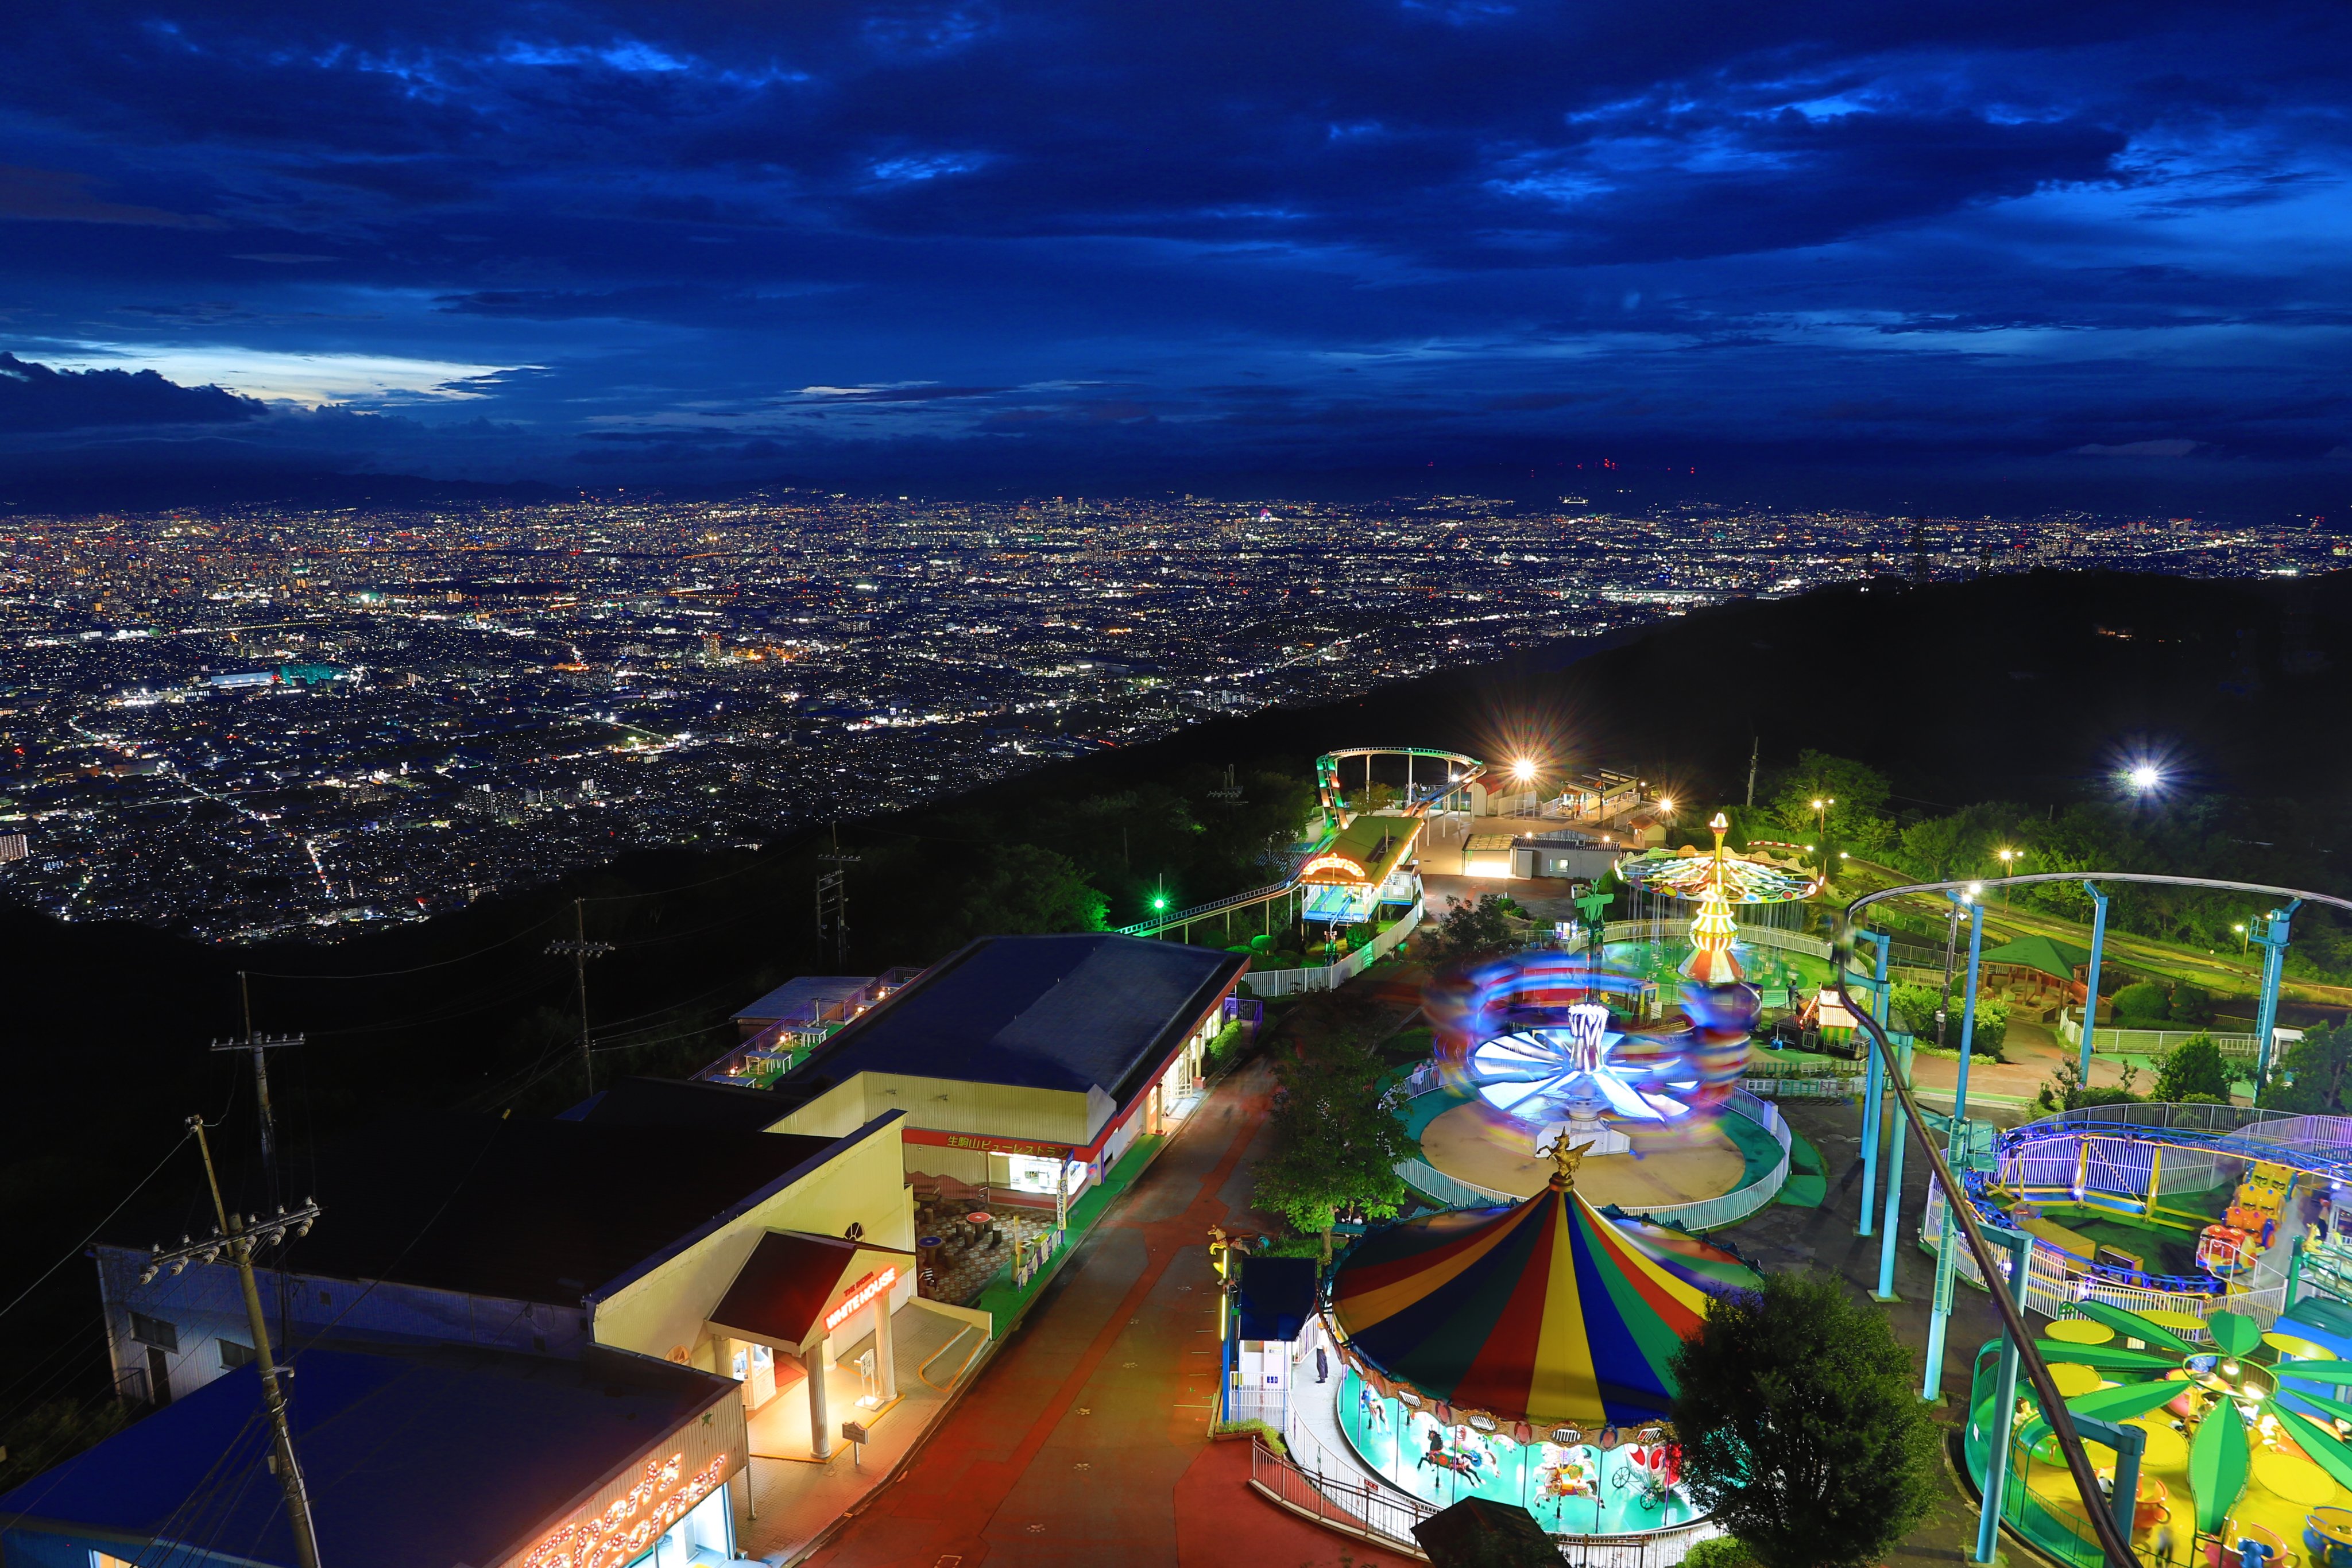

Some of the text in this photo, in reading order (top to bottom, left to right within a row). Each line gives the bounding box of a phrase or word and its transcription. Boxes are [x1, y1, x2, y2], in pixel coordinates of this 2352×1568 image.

[947, 1135, 1068, 1158] 生駒山ビューレストラン
[825, 1267, 895, 1330] WHITE HOUSE
[844, 1284, 856, 1297] THE
